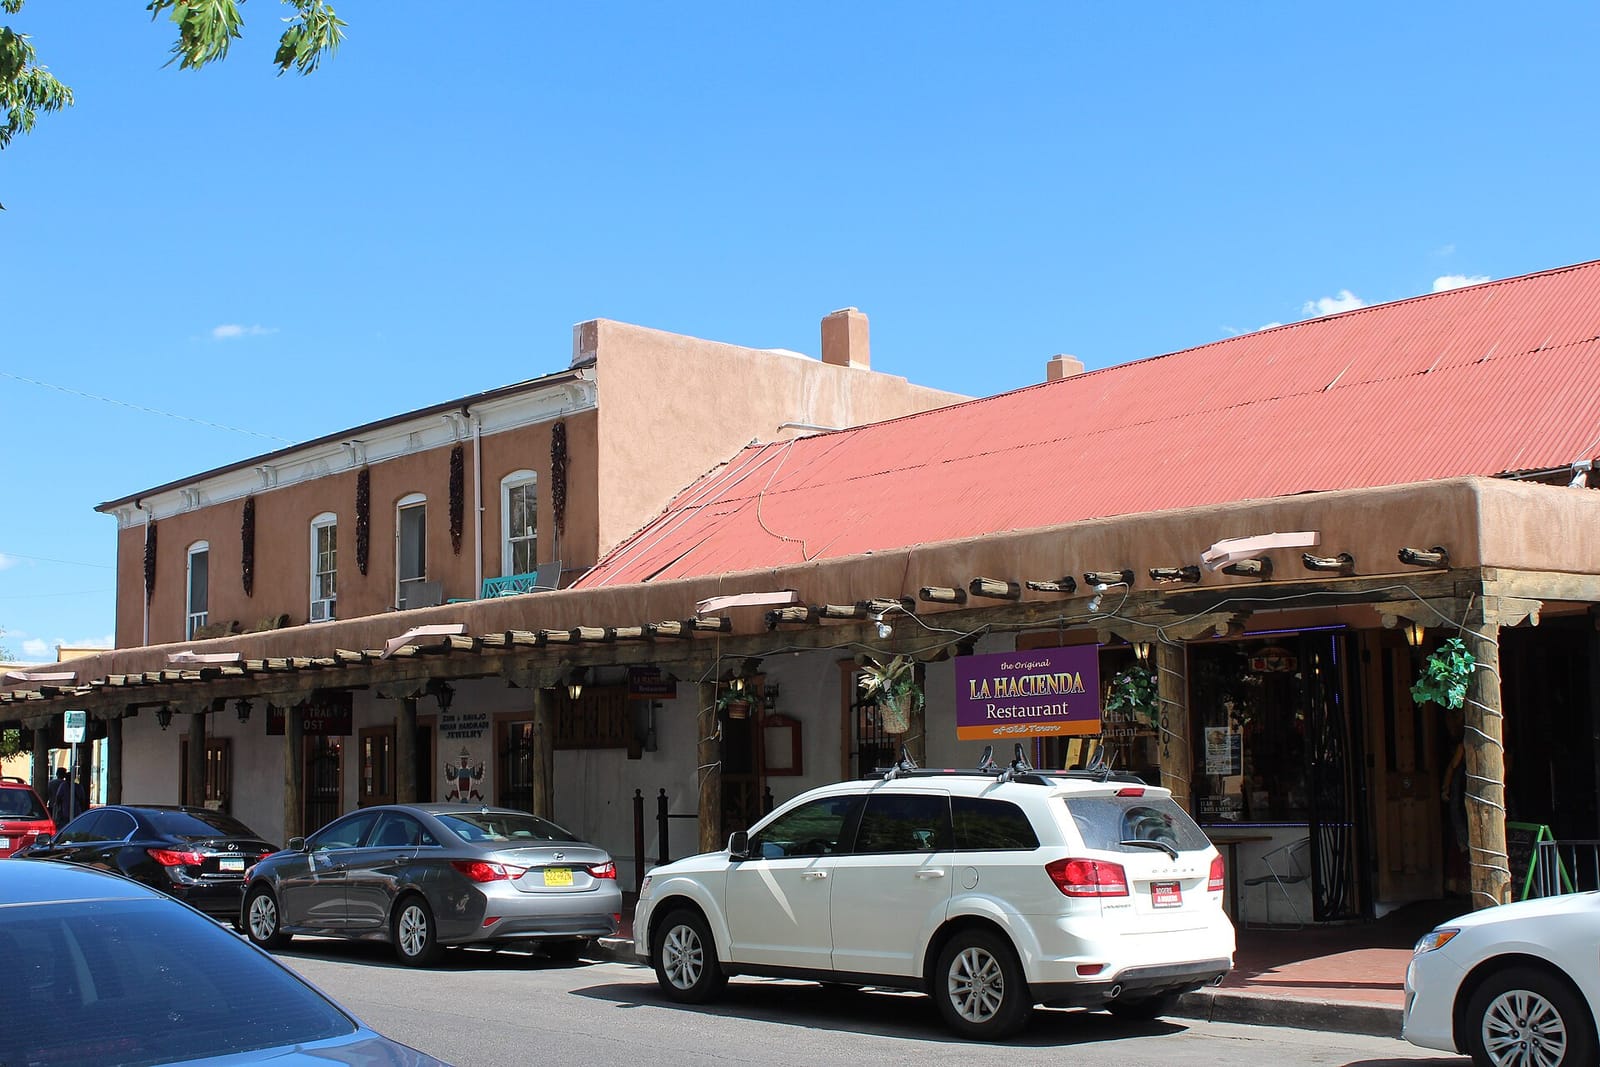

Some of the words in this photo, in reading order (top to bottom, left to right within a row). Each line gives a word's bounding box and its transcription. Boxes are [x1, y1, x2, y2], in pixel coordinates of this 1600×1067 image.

[1000, 662, 1014, 671] the
[1014, 658, 1051, 671] Original
[969, 678, 992, 700] LA
[993, 671, 1086, 699] HACIENDA
[986, 701, 1069, 719] Restaurant
[303, 719, 324, 730] OST
[1006, 724, 1028, 734] Old
[1029, 724, 1061, 732] Town
[446, 729, 483, 738] JEWELRY
